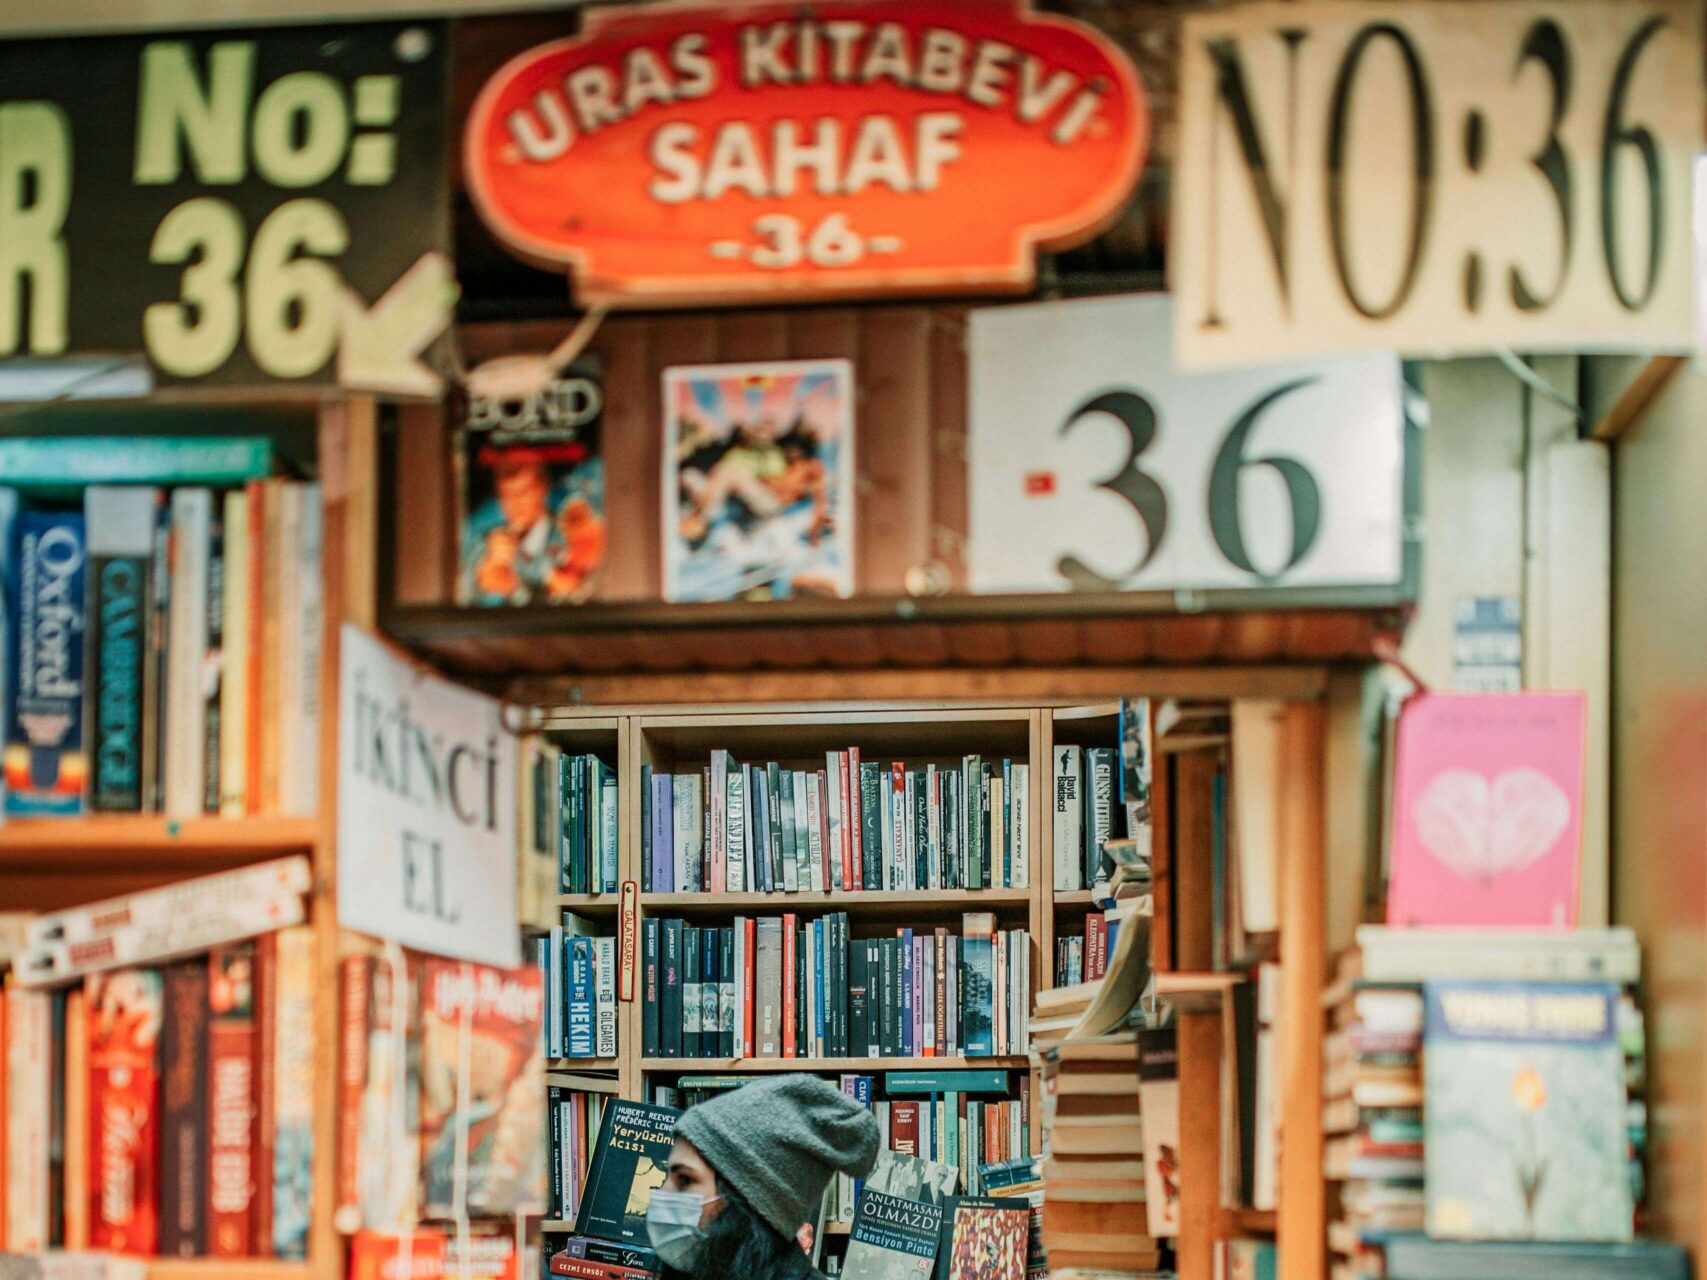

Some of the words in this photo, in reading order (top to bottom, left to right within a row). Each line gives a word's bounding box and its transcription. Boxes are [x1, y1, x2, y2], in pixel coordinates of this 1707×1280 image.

[508, 32, 718, 162] URAS
[740, 8, 1110, 146] KİTABEVİ
[133, 40, 400, 188] No:
[649, 112, 963, 203] SAHAF
[1196, 12, 1670, 330] NO:36
[143, 196, 351, 379] 36
[1052, 375, 1324, 592] 36
[36, 525, 86, 697] Oxford
[1056, 775, 1067, 813] Baldacci
[1067, 775, 1077, 800] David
[1095, 764, 1110, 844] GUNSMITHING
[895, 819, 904, 863] ÇANAKKALE
[623, 909, 633, 972] GALATASARAY
[615, 1114, 652, 1128] FRÉDÉRIC
[654, 1121, 674, 1132] LENO
[617, 1105, 646, 1118] HUBERT
[648, 1111, 676, 1124] REEVES
[609, 1136, 646, 1153] Acısı
[863, 1202, 941, 1232] OLMAZDI
[867, 1192, 943, 1218] ANLATMASAM
[622, 1250, 644, 1266] Gora
[856, 1229, 903, 1249] Bensiyon
[905, 1240, 934, 1256] Pinto
[559, 1263, 580, 1273] CEZMİ
[582, 1267, 604, 1277] ERSÖZ
